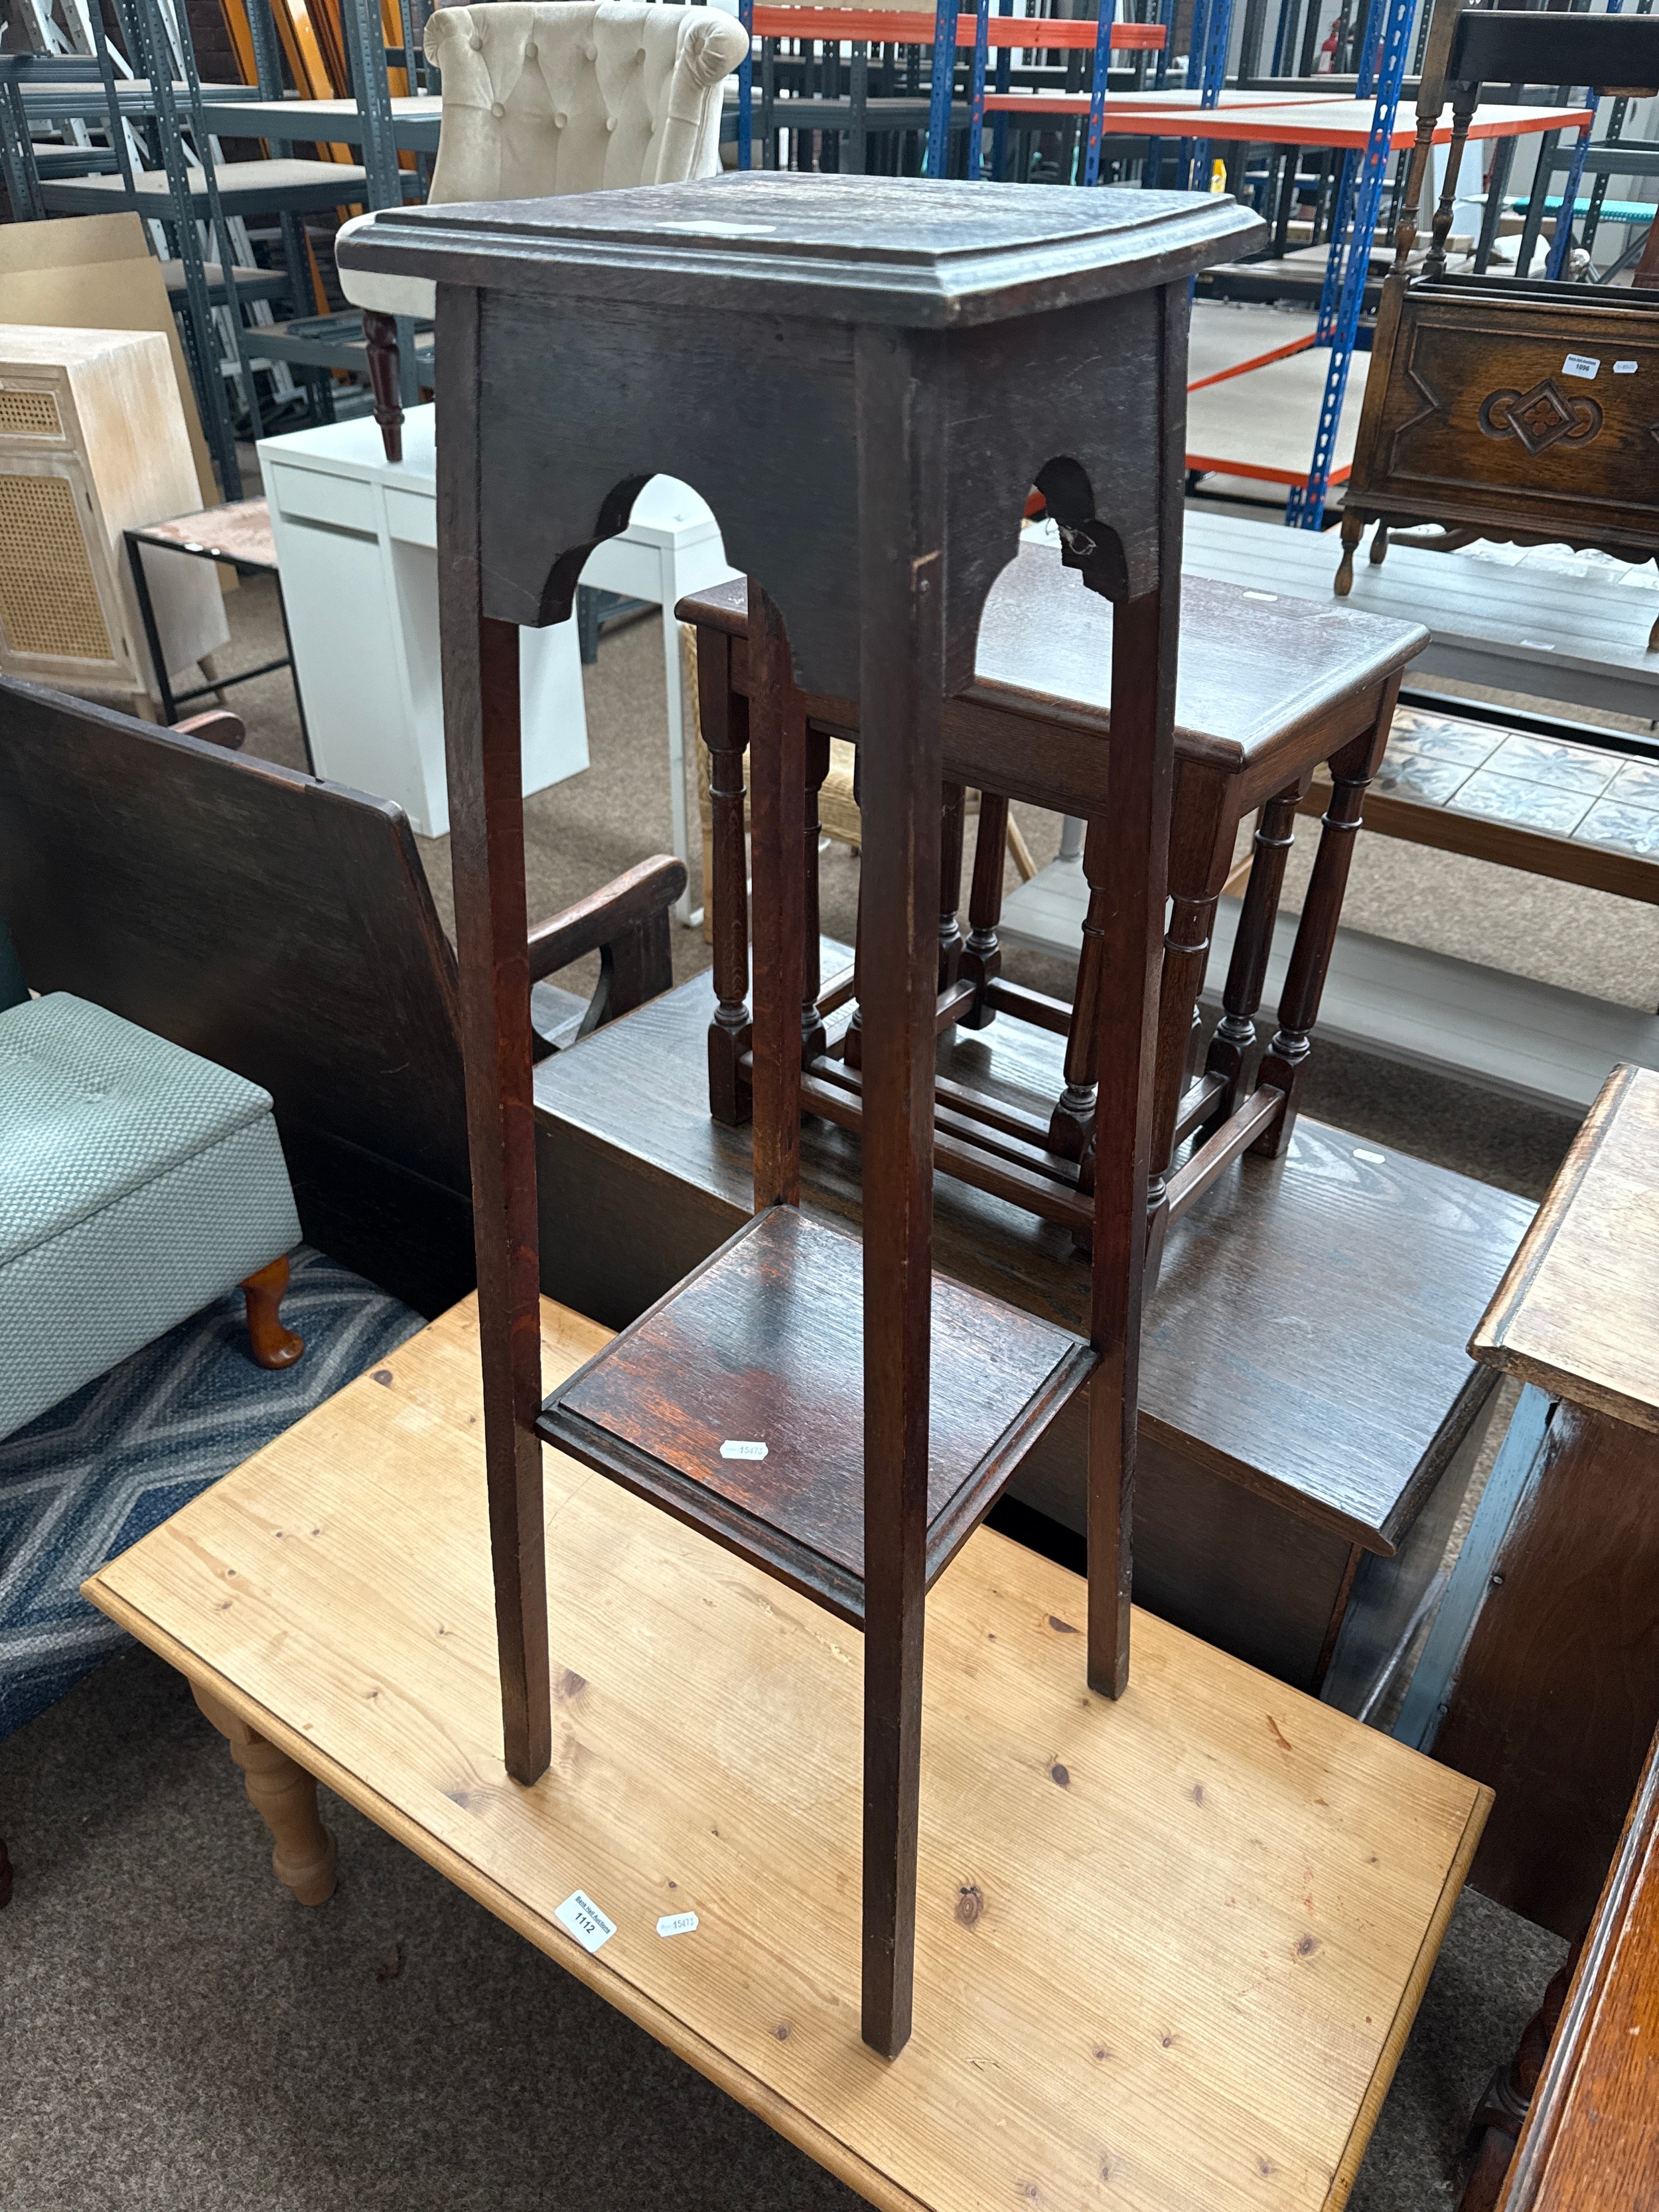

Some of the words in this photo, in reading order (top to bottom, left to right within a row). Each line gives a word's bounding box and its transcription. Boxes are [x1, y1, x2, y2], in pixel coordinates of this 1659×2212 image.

[739, 1446, 763, 1455] 15473
[575, 1895, 587, 1908] Bank
[586, 1906, 595, 1916] Hall
[593, 1914, 611, 1934] Auctions
[575, 1912, 595, 1934] 1112
[673, 1917, 694, 1929] 15473
